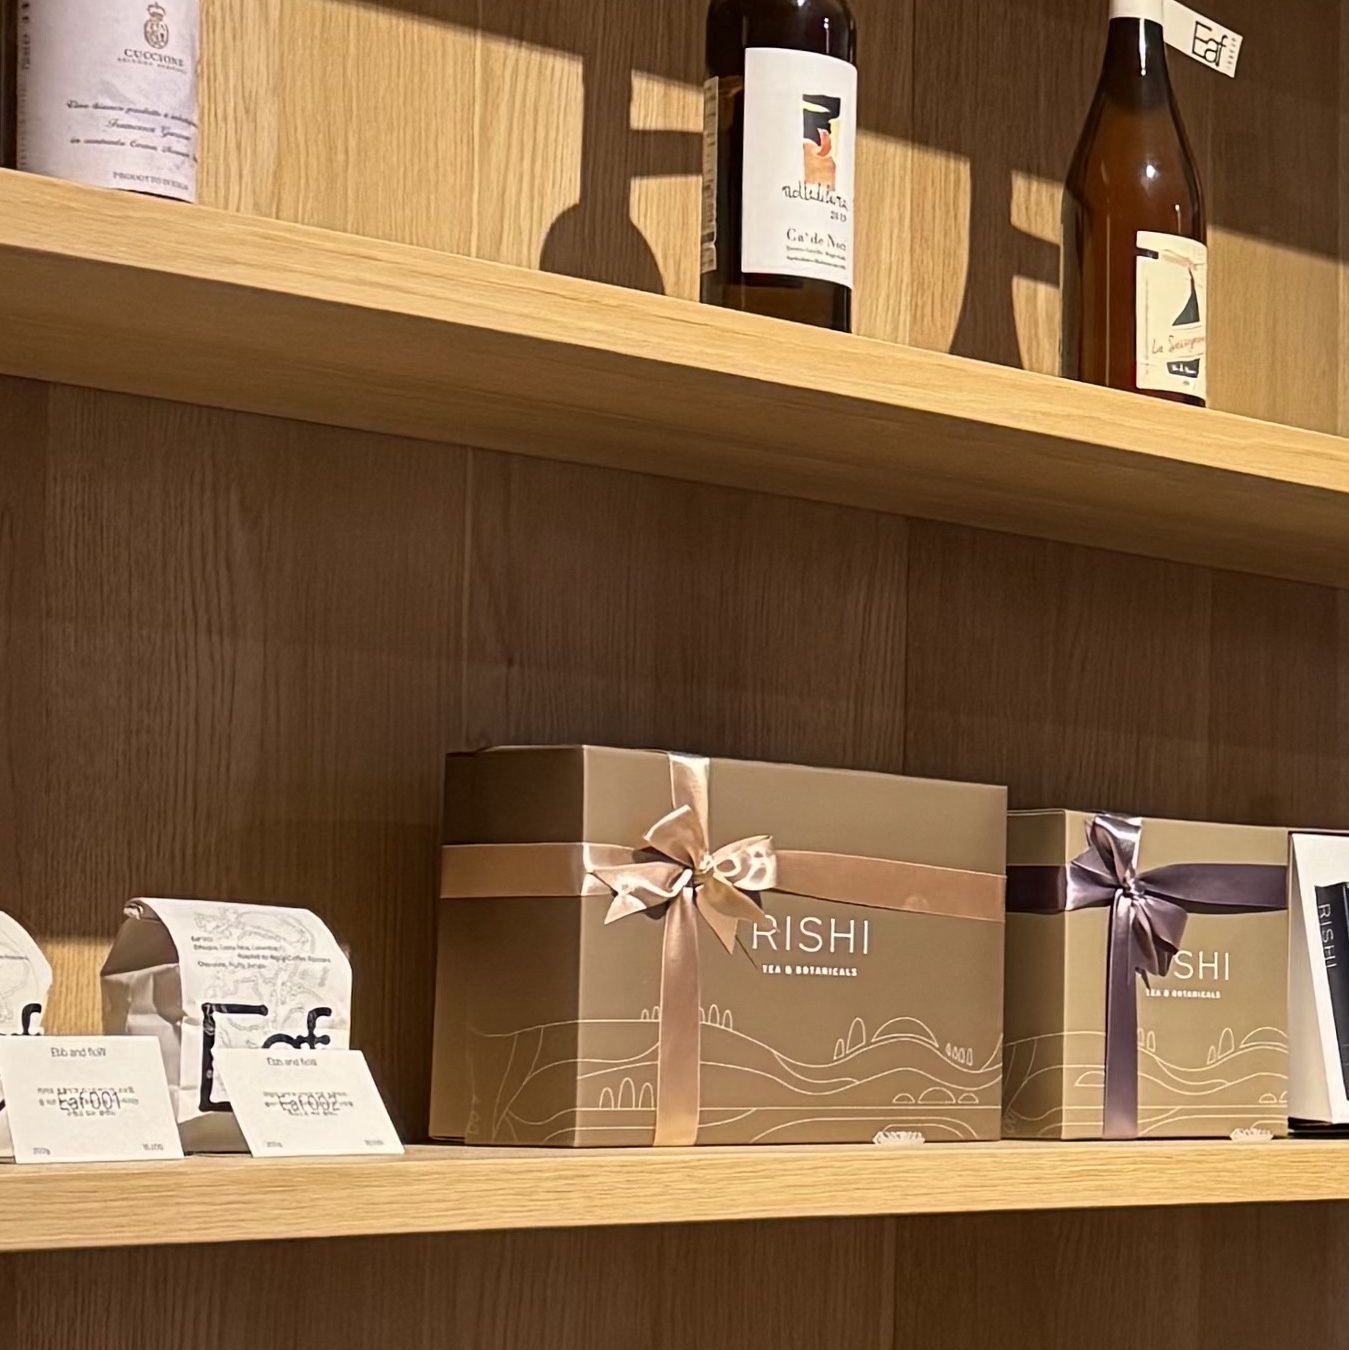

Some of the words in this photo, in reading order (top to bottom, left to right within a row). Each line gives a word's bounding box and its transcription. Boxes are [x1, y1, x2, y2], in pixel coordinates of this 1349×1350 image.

[752, 914, 869, 955] RISHI
[1318, 903, 1337, 969] RISHI
[762, 964, 781, 974] TEA
[795, 965, 858, 977] BOTANICALS
[1174, 949, 1230, 981] SHI
